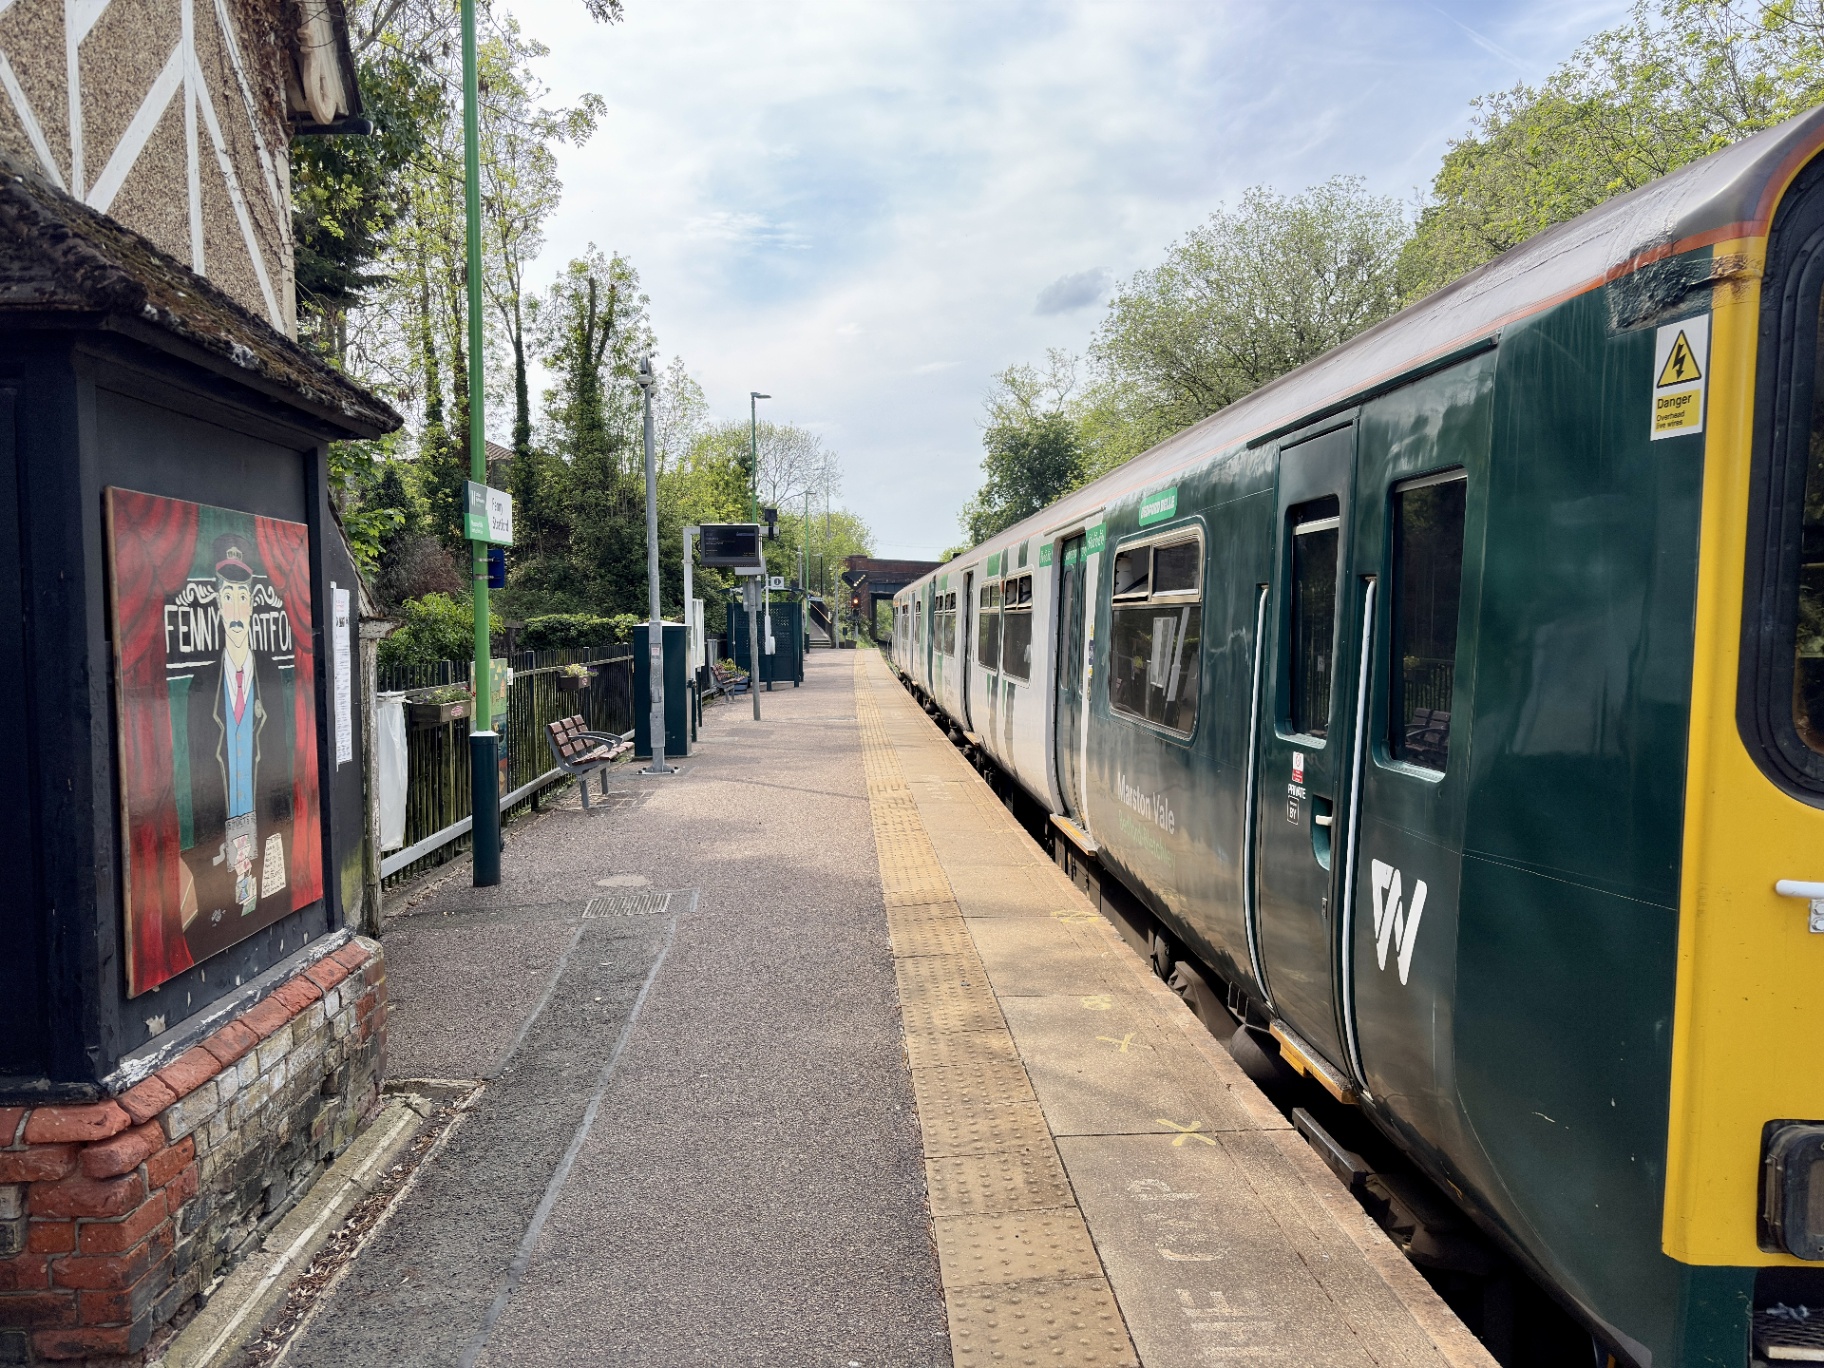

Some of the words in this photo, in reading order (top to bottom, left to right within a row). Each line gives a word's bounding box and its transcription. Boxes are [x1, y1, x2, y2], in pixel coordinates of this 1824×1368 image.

[1657, 394, 1692, 409] Danger
[1656, 410, 1685, 421] Overhead
[164, 604, 221, 654] FENNY
[1287, 783, 1306, 800] PRIVATE
[1118, 772, 1151, 820] Marston
[1153, 791, 1175, 835] Vale
